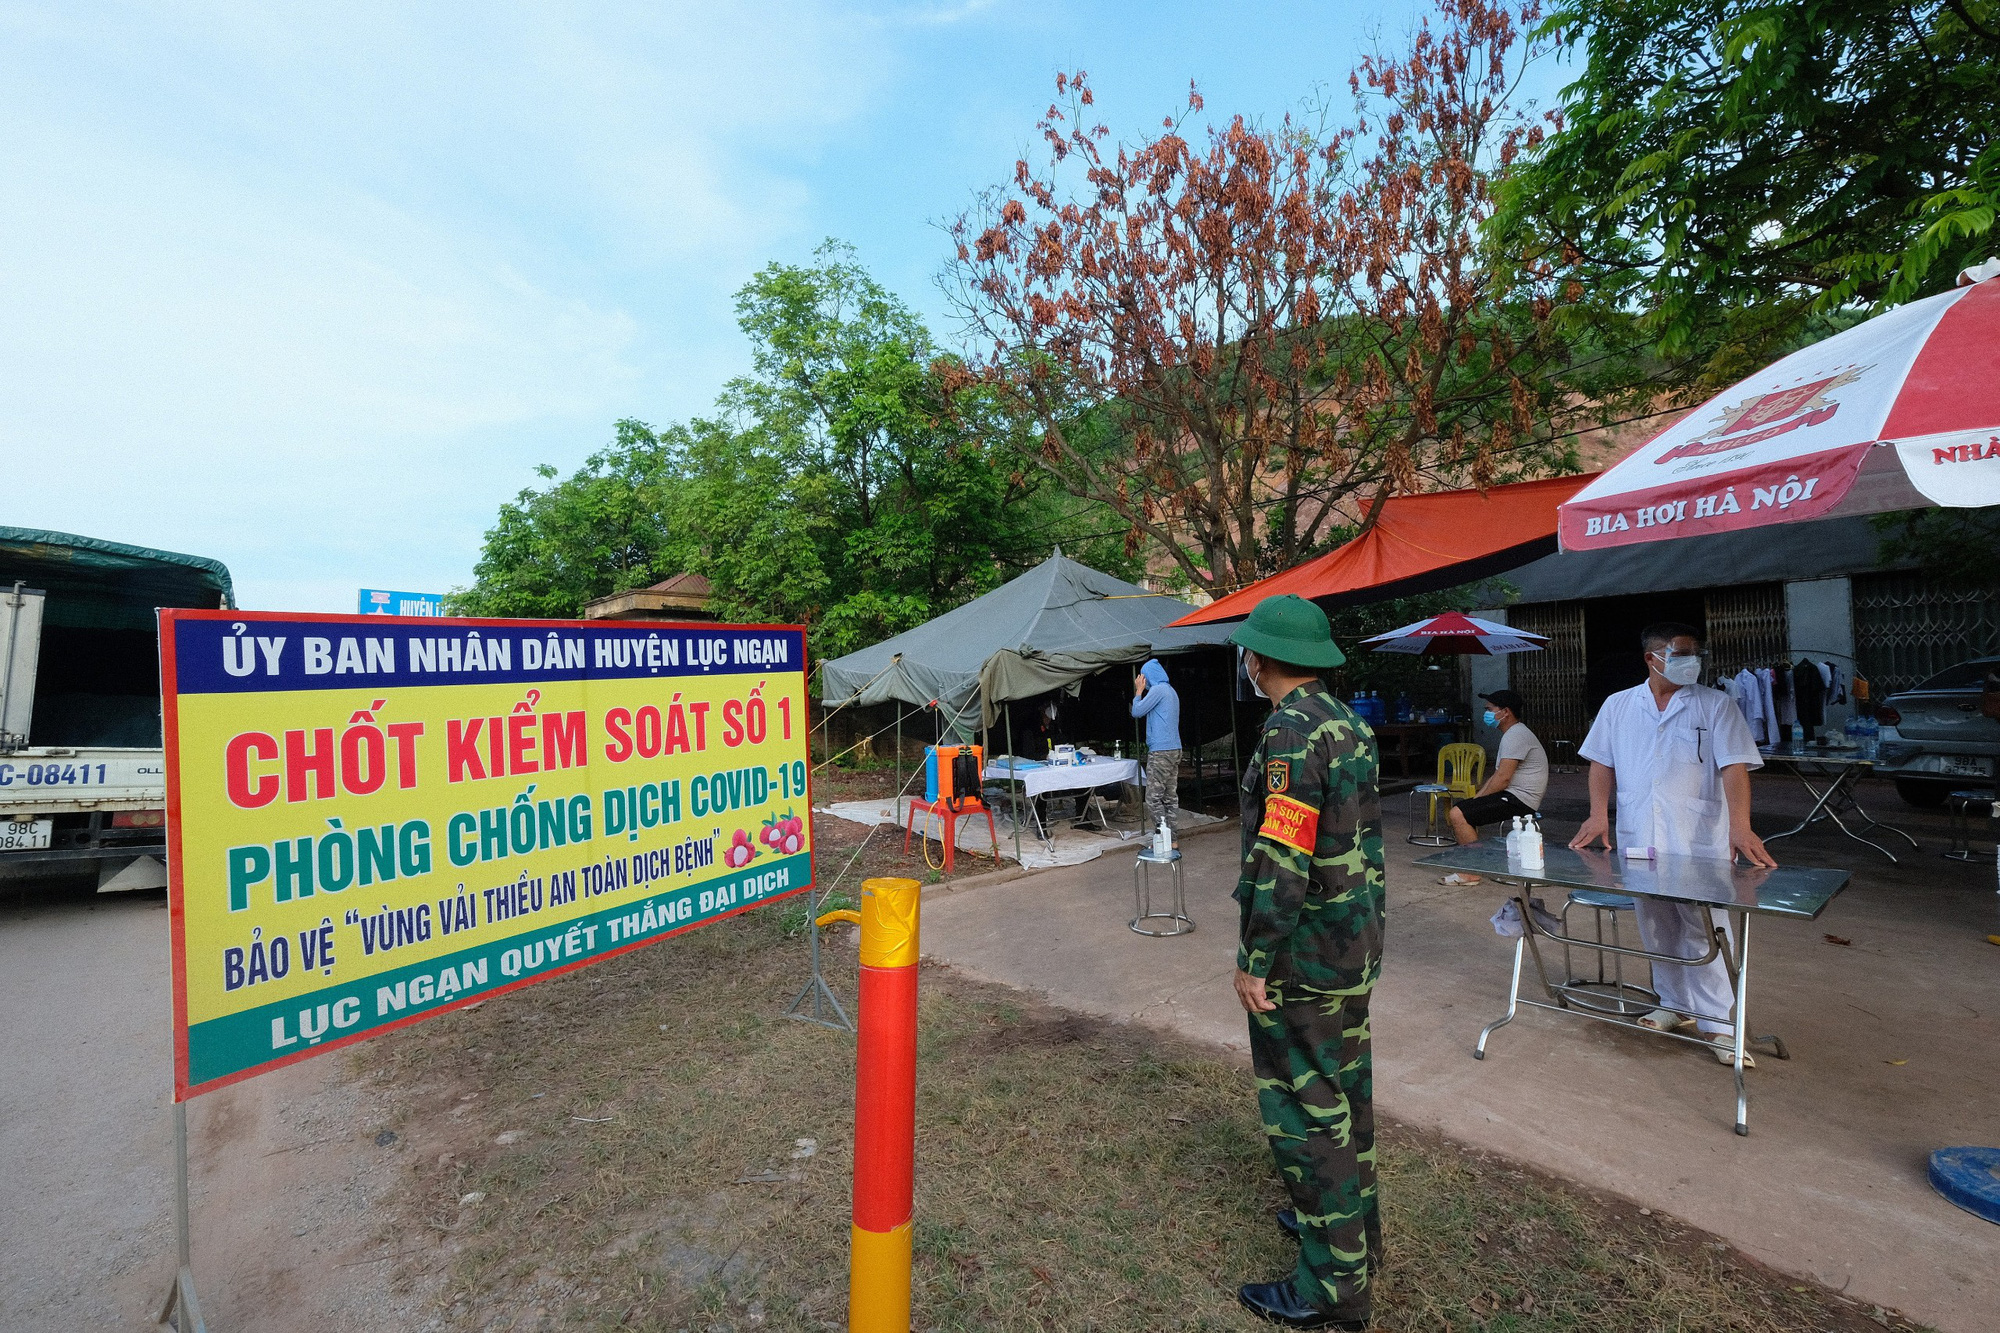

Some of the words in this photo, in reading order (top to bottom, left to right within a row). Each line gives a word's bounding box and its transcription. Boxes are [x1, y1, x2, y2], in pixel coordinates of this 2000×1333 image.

[1585, 514, 1629, 537] BIA
[1637, 500, 1687, 528] HƠI
[1693, 486, 1741, 519] HÀ
[1751, 474, 1820, 510] NỘI
[222, 622, 287, 677] ỦY
[303, 637, 395, 675] BAN
[408, 631, 511, 673] NHÂN
[522, 632, 586, 670] DÂN
[594, 633, 679, 673] HUYỆN
[686, 638, 727, 671] LỤC
[733, 639, 788, 669] NGẠN
[0, 764, 106, 786] C-08411
[225, 699, 425, 809] CHỐT
[446, 689, 588, 784] KIỂM
[604, 692, 710, 763] SOÁT
[722, 680, 767, 747] SỐ
[777, 696, 791, 740] 1
[8, 822, 39, 835] 98C
[228, 817, 432, 913] PHÒNG
[448, 784, 593, 867] CHỐNG
[603, 779, 681, 842] DỊCH
[690, 760, 806, 818] COVID-19
[1280, 806, 1307, 825] SOÁT
[224, 926, 290, 992] BẢO
[299, 917, 335, 976] VỆ
[345, 903, 432, 956] “VÙNG
[438, 883, 477, 936] VẢI
[483, 869, 543, 924] THIỀU
[550, 870, 576, 908] AN
[581, 855, 628, 898] TOÀN
[633, 847, 670, 889] DỊCH
[675, 828, 720, 878] BỆNH”
[271, 996, 360, 1049] LỤC
[377, 957, 488, 1016] NGẠN
[501, 921, 598, 976] QUYẾT
[607, 900, 692, 943] THẮNG
[699, 883, 736, 912] ĐẠI
[743, 867, 789, 899] DỊCH
